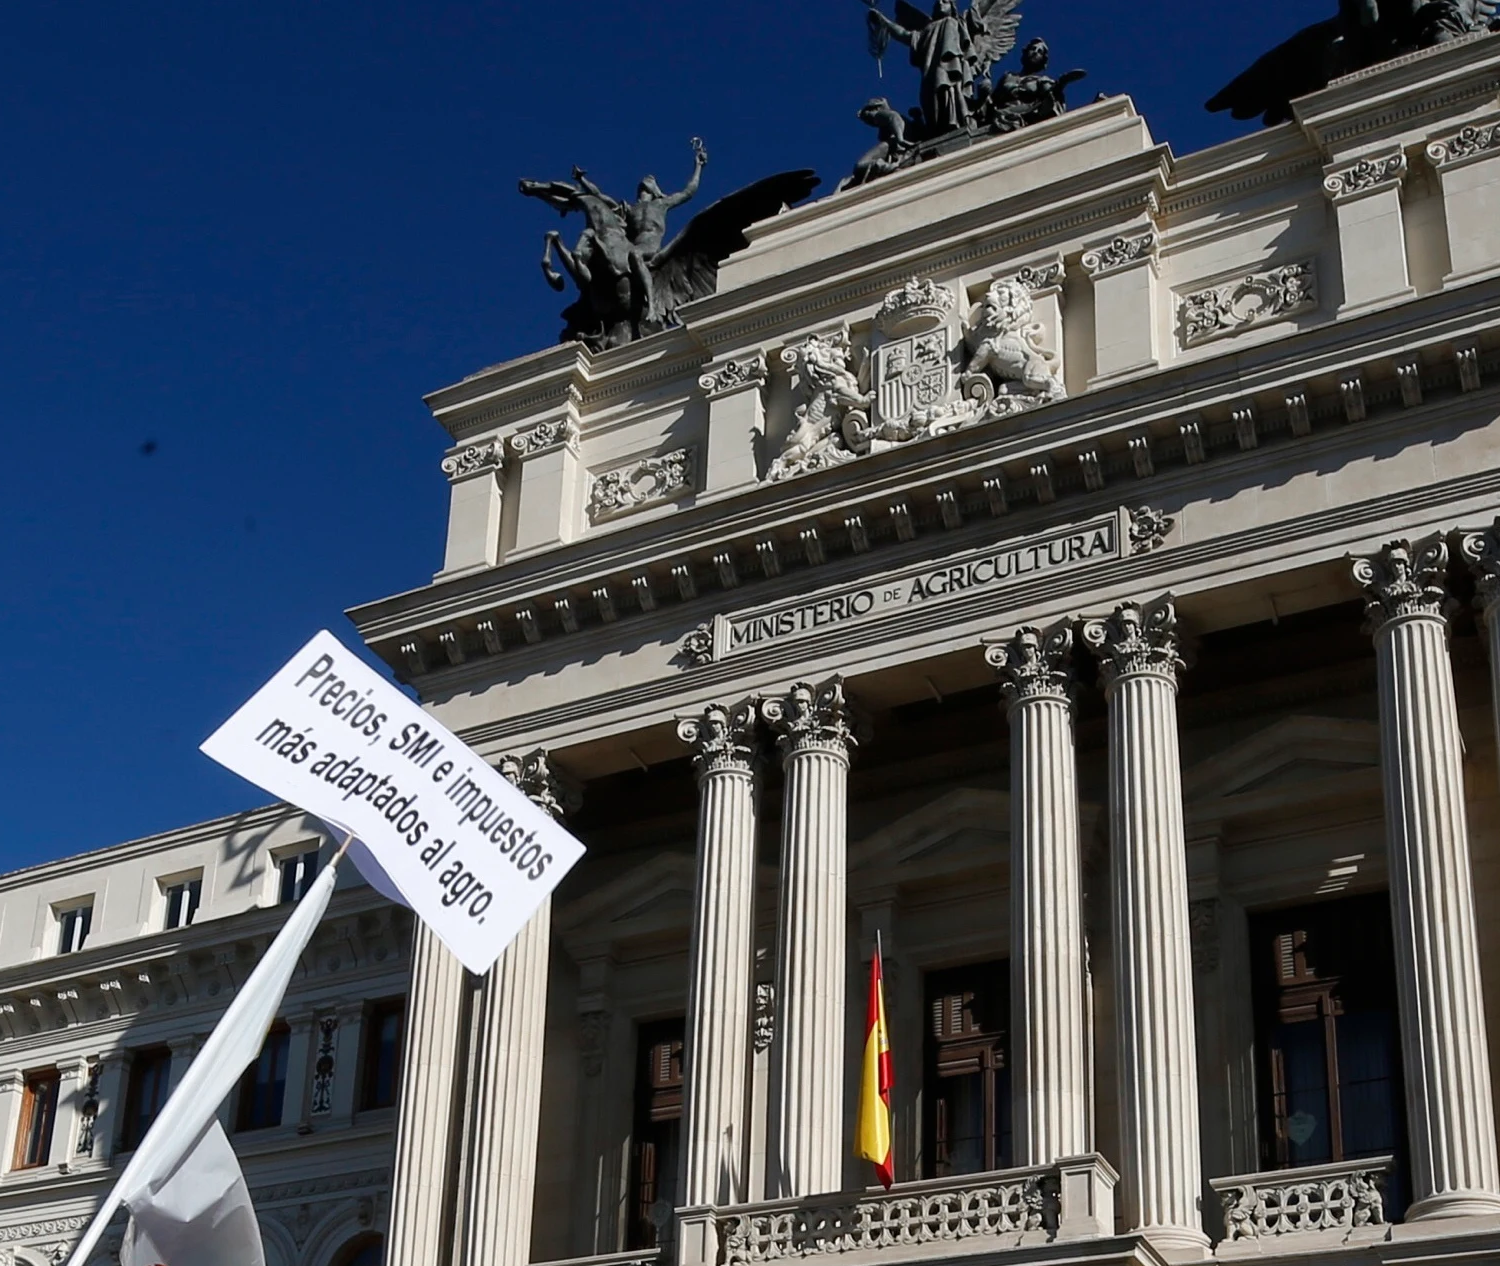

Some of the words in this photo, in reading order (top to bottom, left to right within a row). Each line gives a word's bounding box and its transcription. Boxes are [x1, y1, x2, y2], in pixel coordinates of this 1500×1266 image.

[730, 591, 873, 648] MINISTERIO
[884, 588, 902, 603] DE
[908, 531, 1108, 603] AGRICULTURA
[255, 718, 317, 765] más
[310, 756, 429, 847] adaptados
[421, 841, 457, 871] al
[439, 860, 494, 925] agro.
[295, 653, 388, 746] Precios,
[389, 723, 445, 768] SMI
[432, 761, 454, 783] e
[445, 767, 553, 881] impuestos
